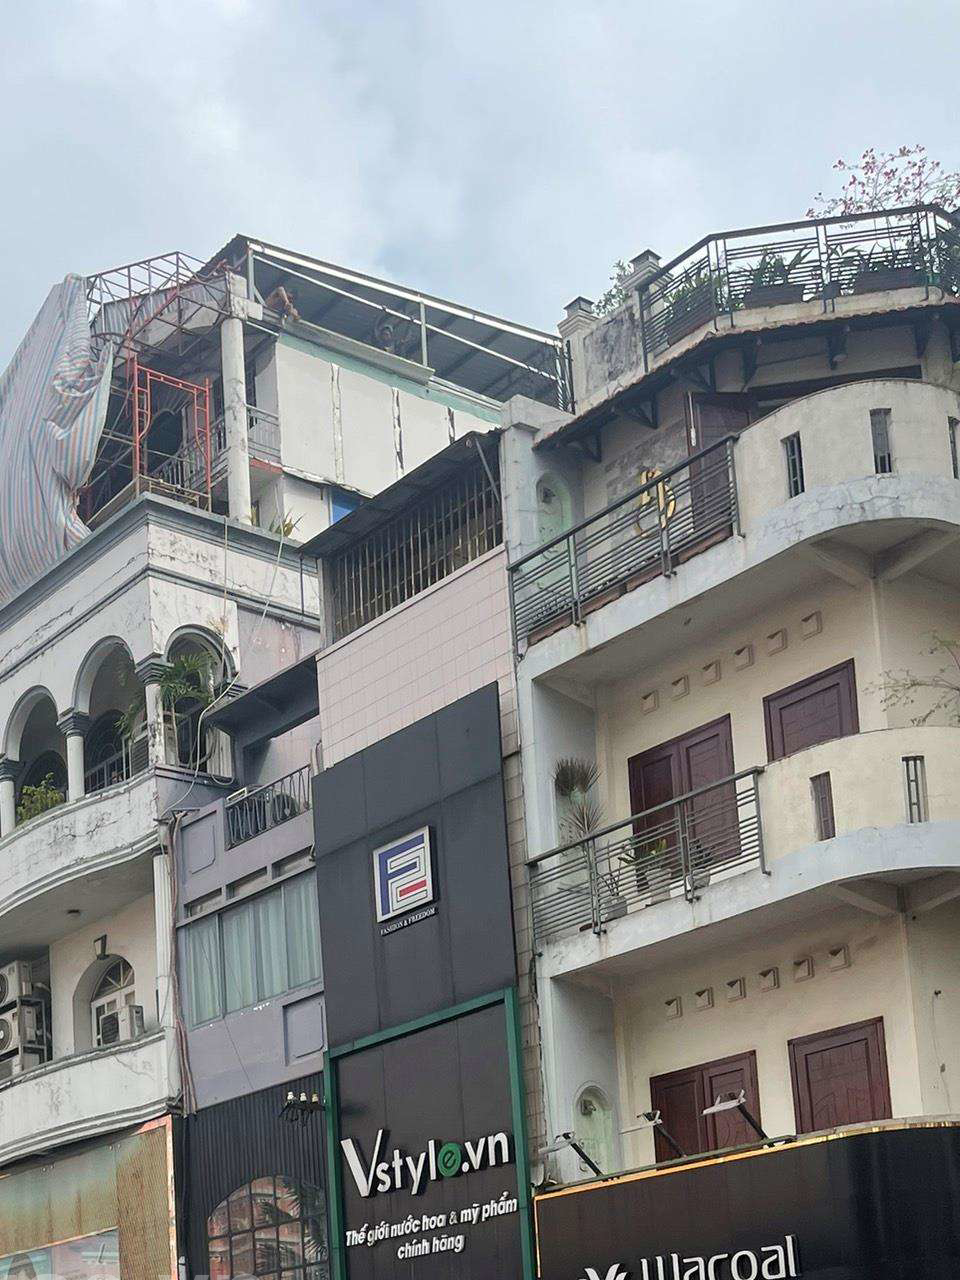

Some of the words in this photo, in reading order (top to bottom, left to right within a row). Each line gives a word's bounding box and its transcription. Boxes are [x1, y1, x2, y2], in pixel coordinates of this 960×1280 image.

[341, 1129, 509, 1197] Vstyle.vn
[345, 1222, 367, 1247] Thế
[367, 1220, 390, 1247] giới
[391, 1214, 421, 1239] nước
[422, 1214, 446, 1231] hoa
[448, 1211, 458, 1226] &
[460, 1203, 481, 1225] mỹ
[481, 1191, 518, 1222] phẩm
[397, 1236, 430, 1260] chính
